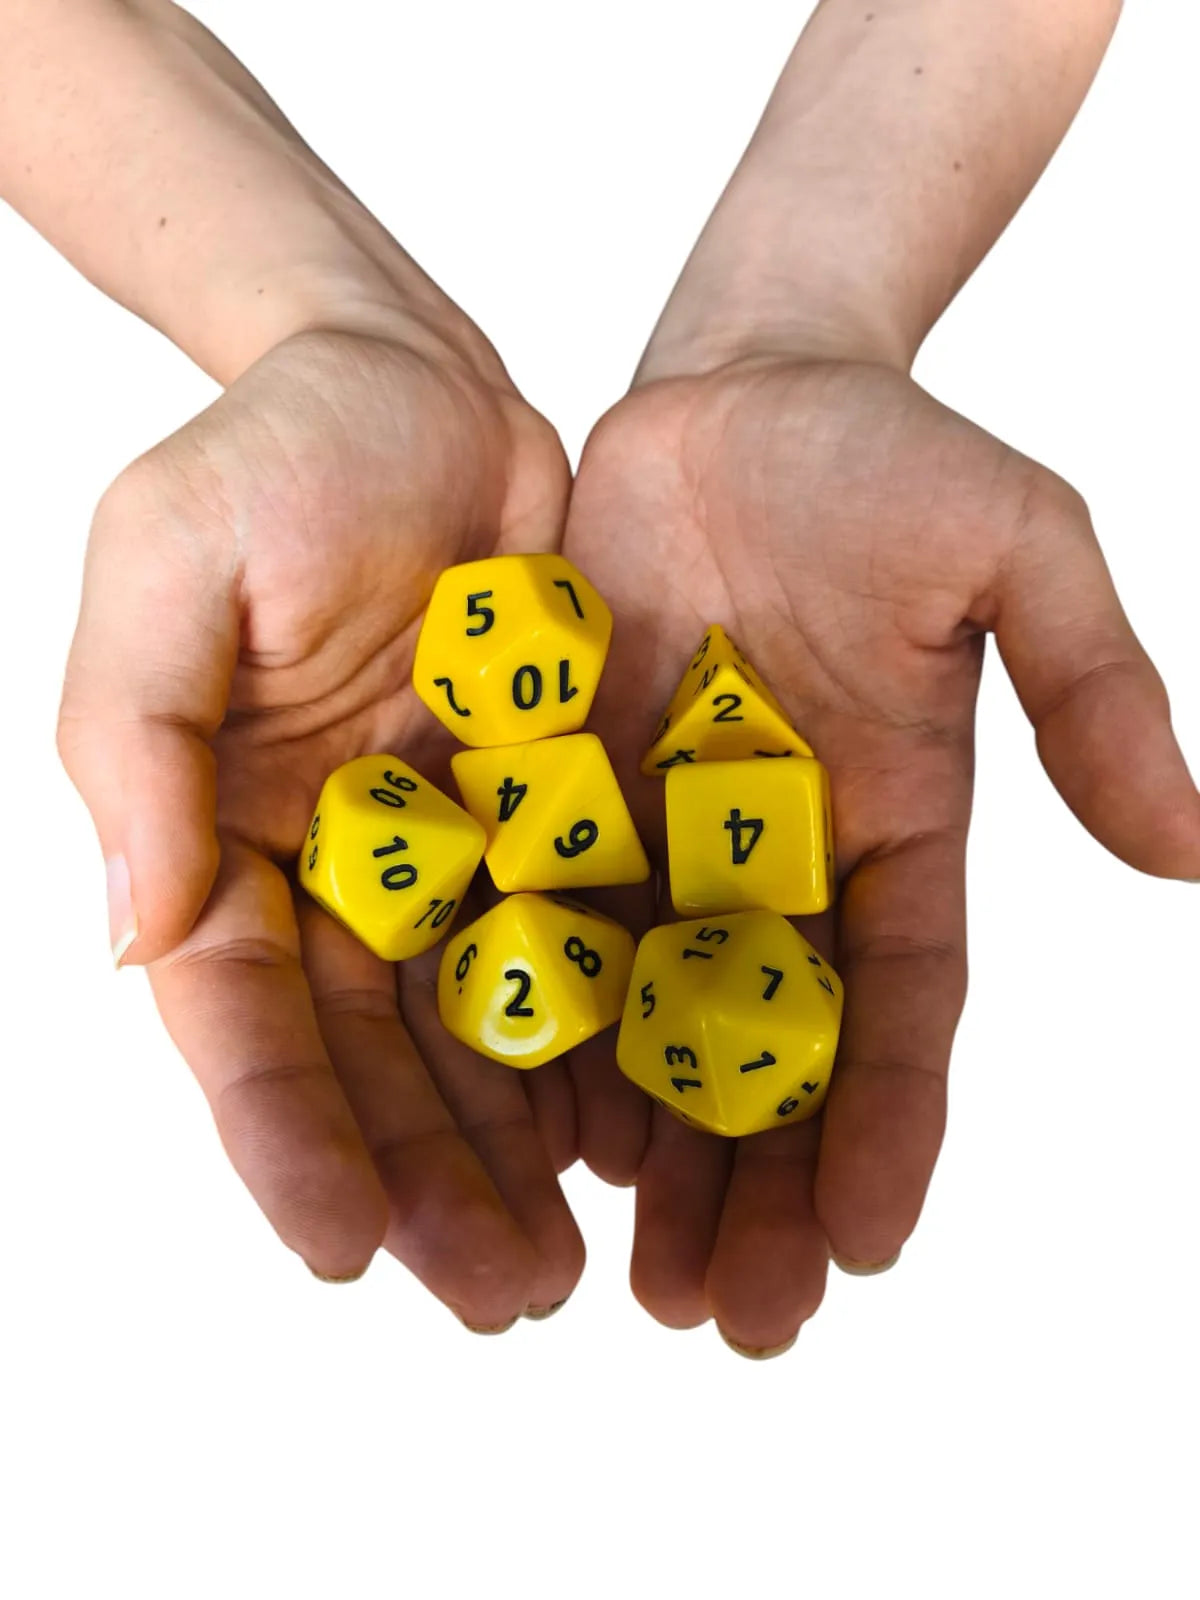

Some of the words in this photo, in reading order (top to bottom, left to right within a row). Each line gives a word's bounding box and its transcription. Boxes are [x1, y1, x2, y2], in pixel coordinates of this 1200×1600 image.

[466, 590, 495, 636] 5
[512, 659, 579, 710] 10
[711, 694, 744, 723] 2
[497, 776, 528, 823] 4
[724, 808, 764, 865] 4
[372, 835, 418, 890] 10
[414, 899, 456, 929] 70
[564, 936, 602, 978] 8
[683, 927, 729, 960] 15
[505, 969, 534, 1017] 2
[641, 982, 656, 1019] 5
[761, 965, 784, 1001] 7
[664, 1045, 702, 1094] 13
[739, 1051, 776, 1073] 1
